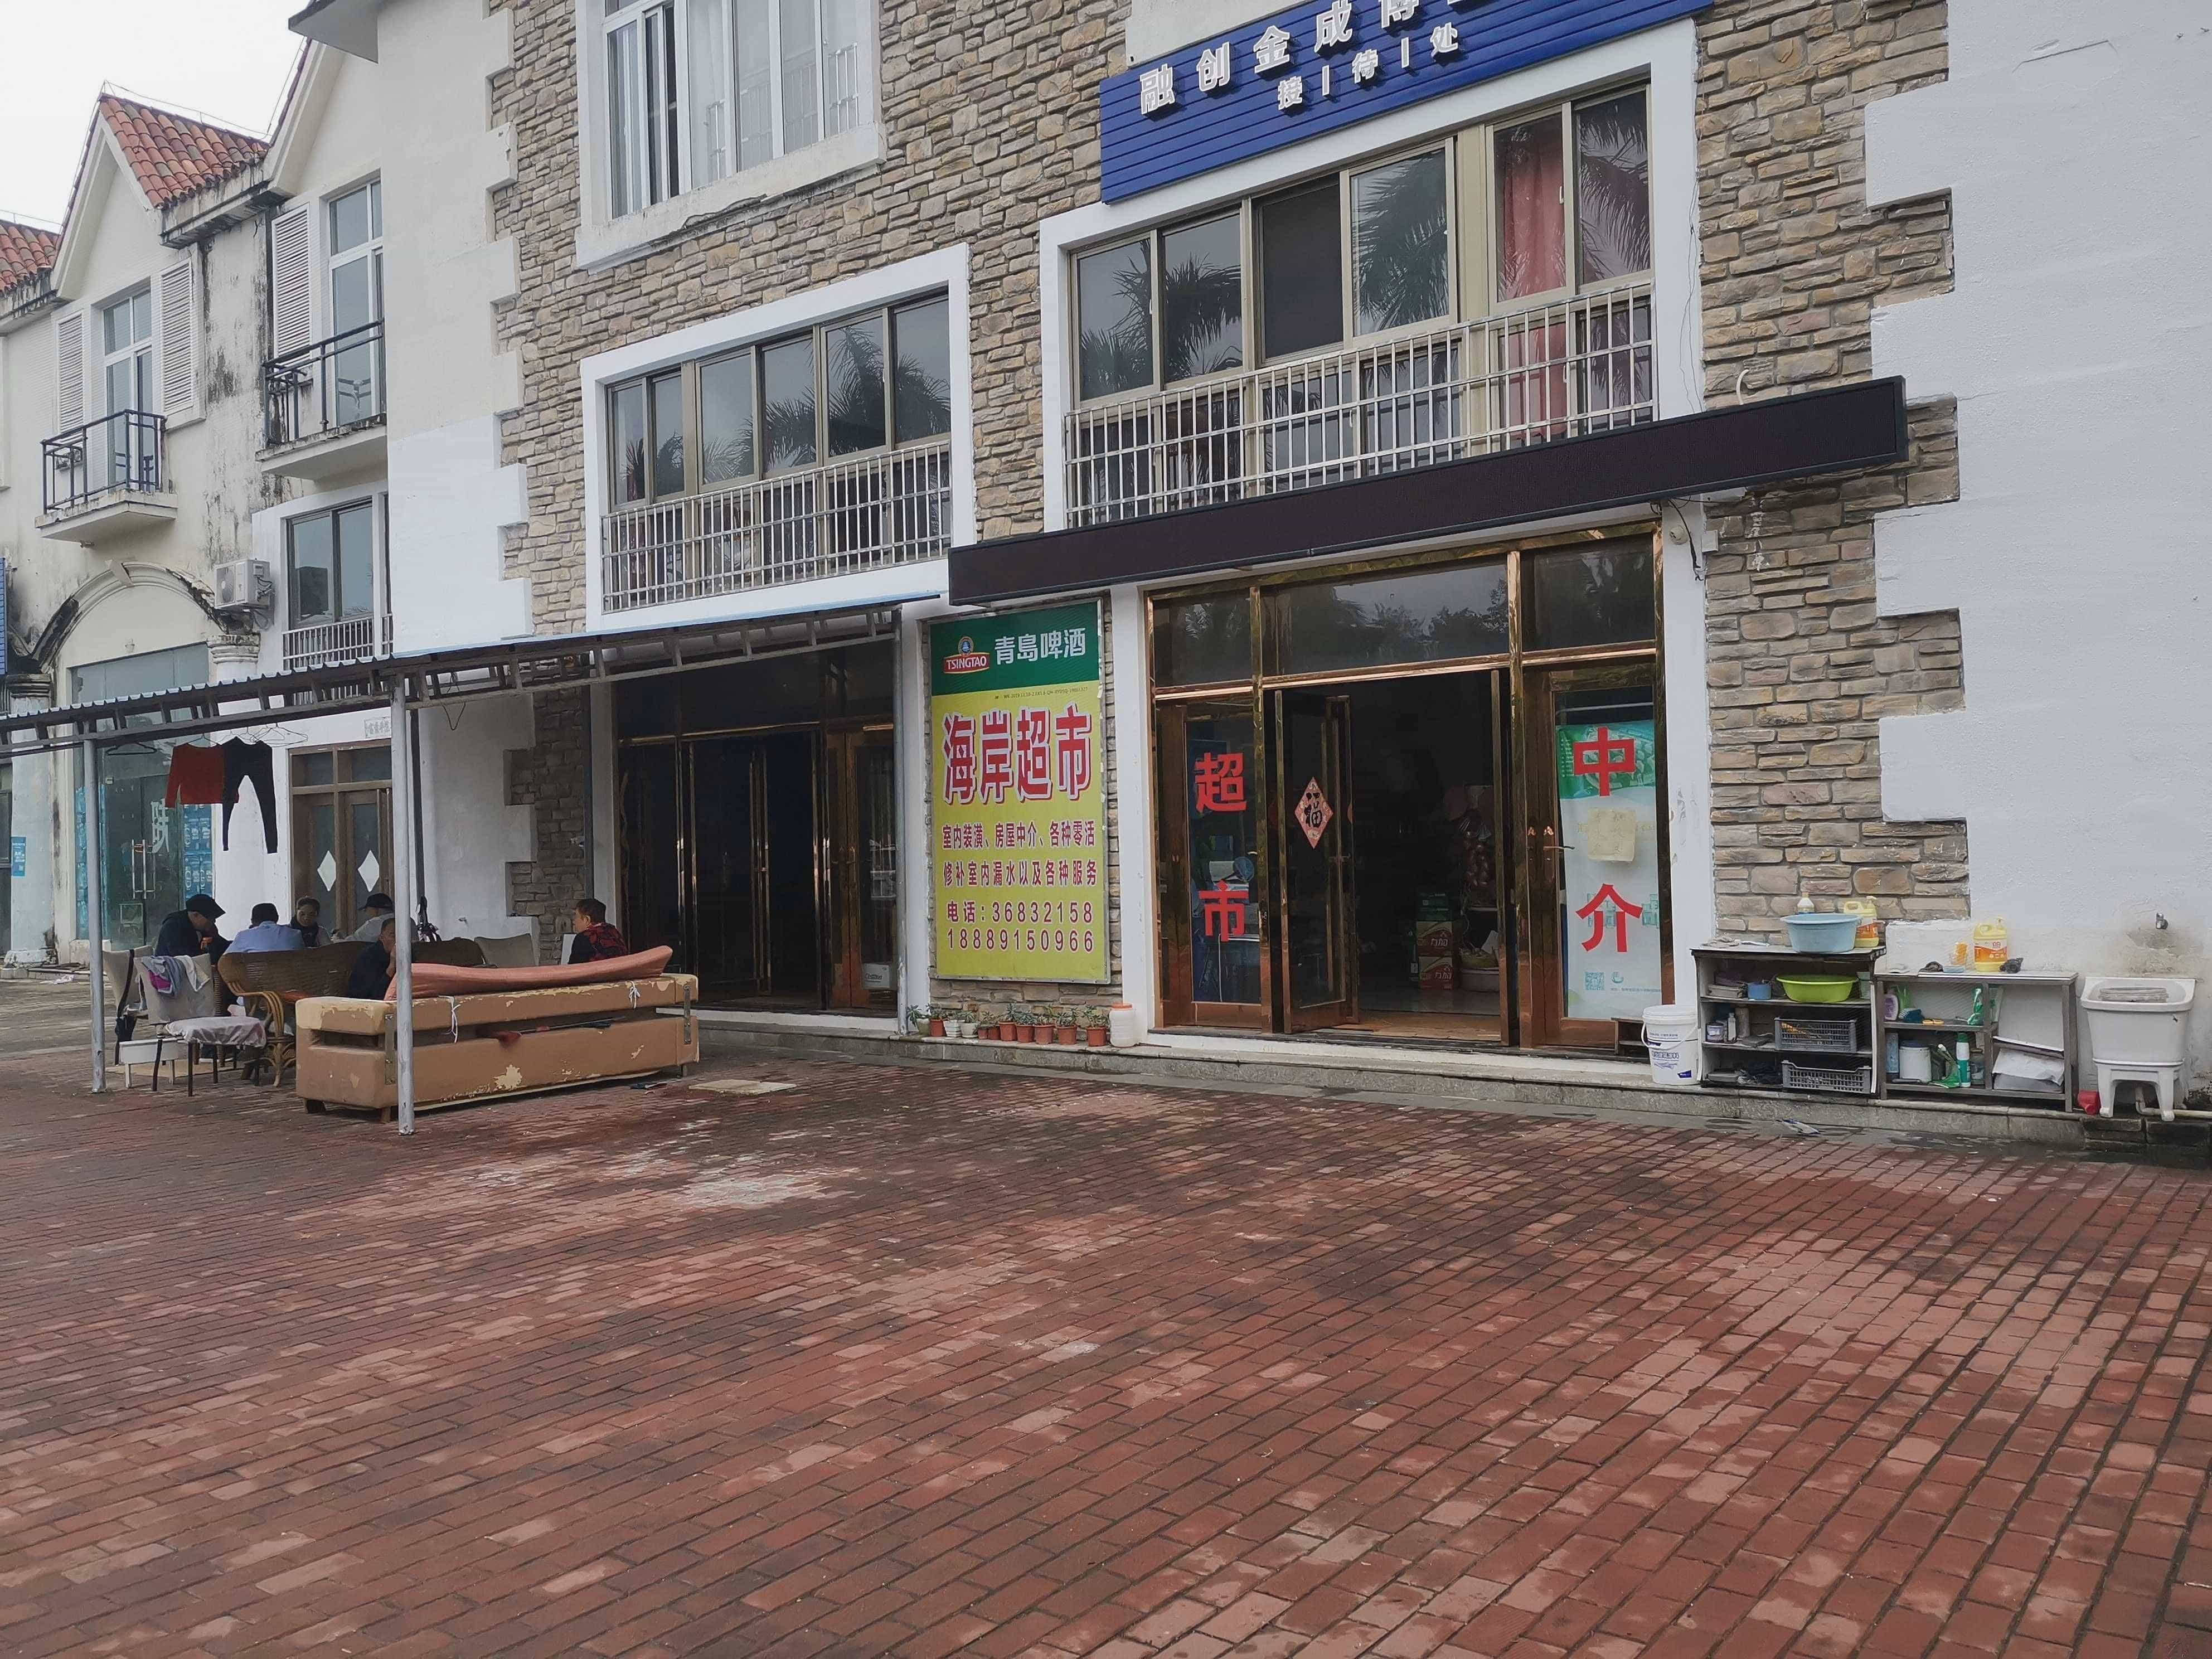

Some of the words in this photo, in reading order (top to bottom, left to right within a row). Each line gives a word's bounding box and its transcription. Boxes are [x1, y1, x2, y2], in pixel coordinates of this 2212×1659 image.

[946, 656, 987, 670] TSINGTAO
[995, 628, 1085, 665] 青岛啤酒
[942, 701, 1093, 804] 海岸超市
[1195, 753, 1249, 941] 超市
[1574, 726, 1642, 953] 中介
[943, 859, 1097, 886] 修补室内漏水以及各种服务
[948, 928, 1093, 952] 18889150966
